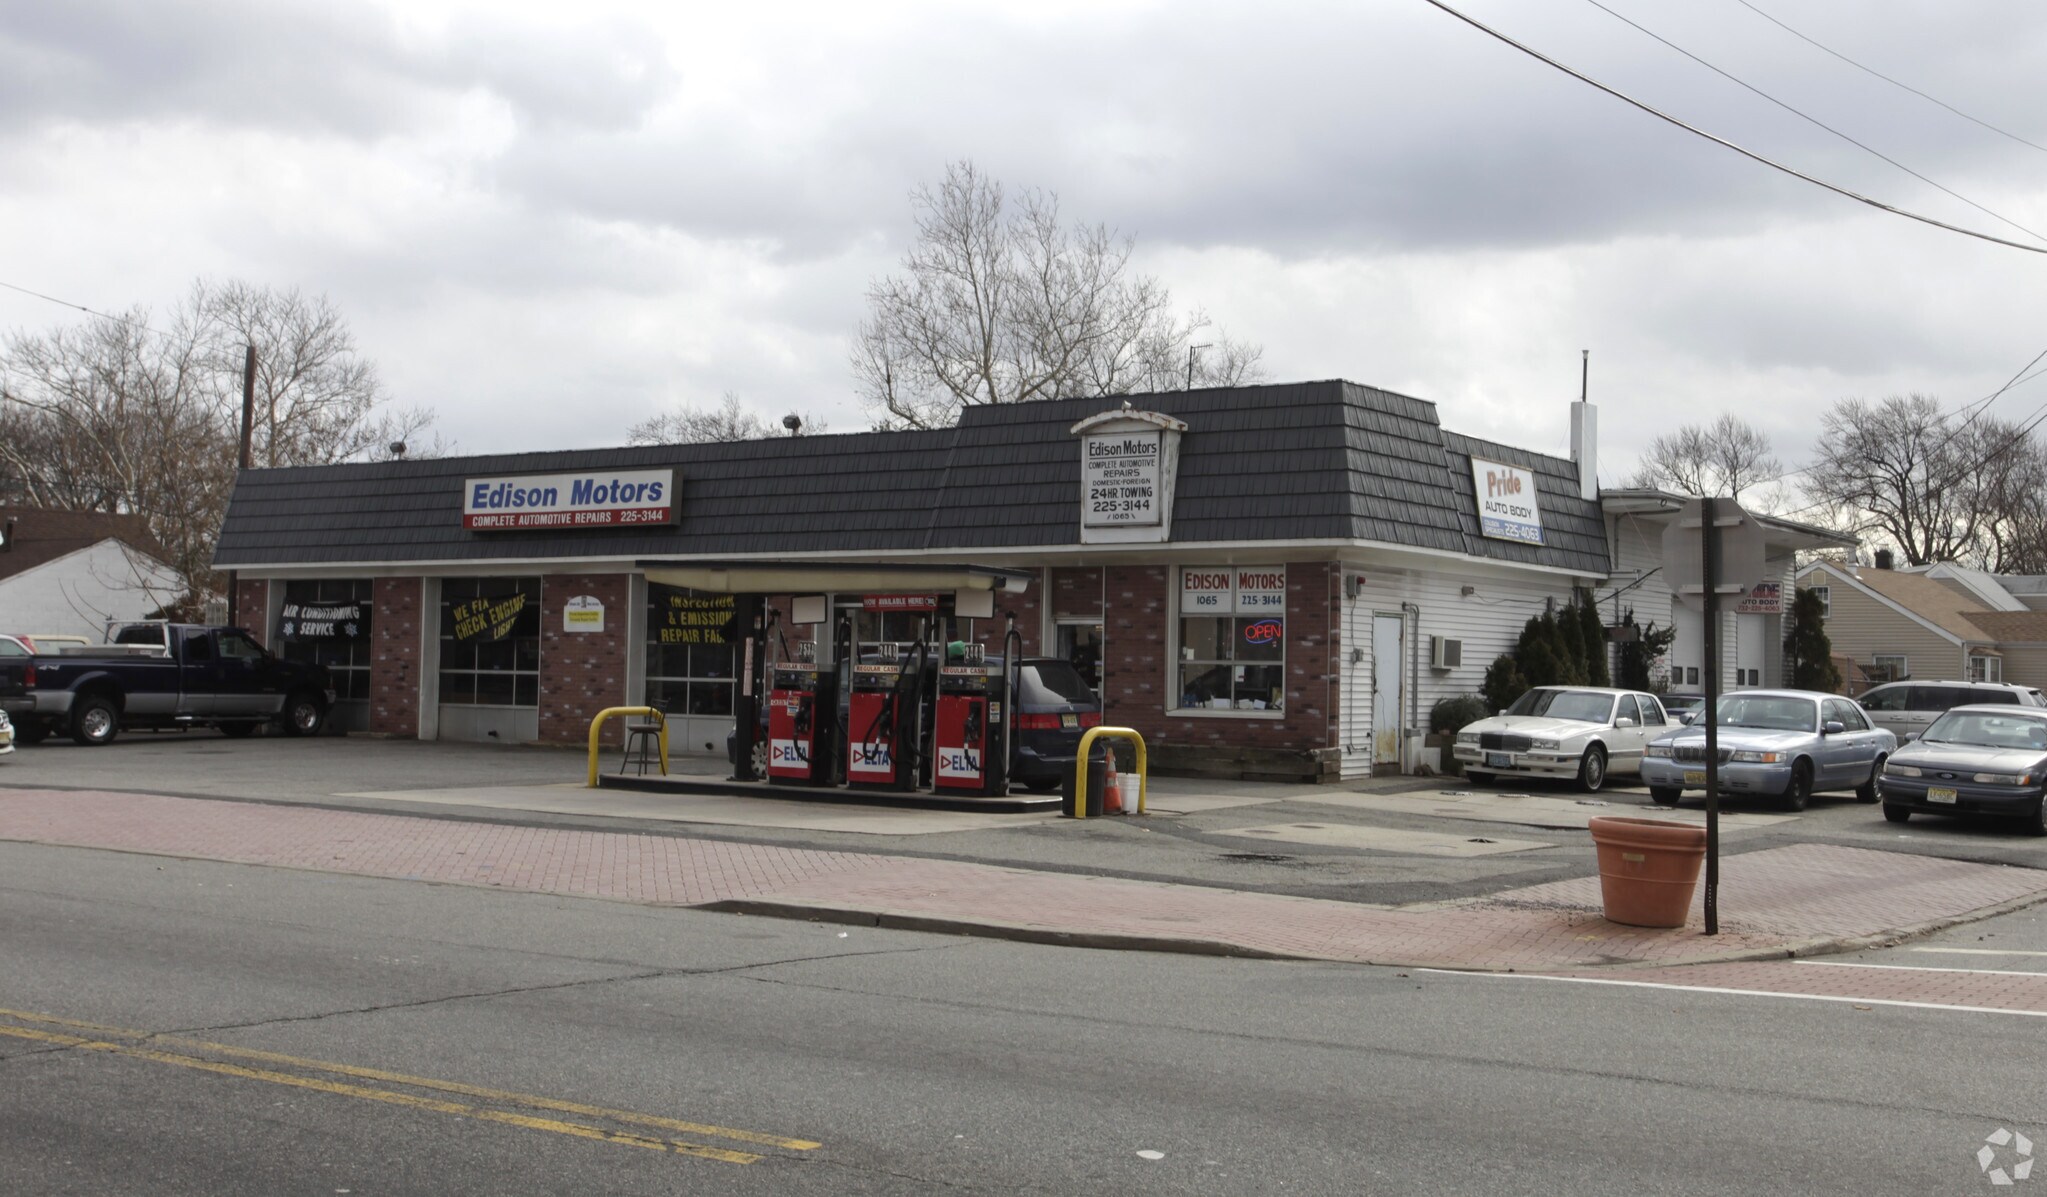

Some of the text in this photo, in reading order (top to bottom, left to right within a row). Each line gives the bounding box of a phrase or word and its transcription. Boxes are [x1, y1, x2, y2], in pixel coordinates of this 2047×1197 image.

[1089, 440, 1157, 456] Edison Motors
[1088, 458, 1155, 470] COMPLETE AUTOMOTIVE
[1103, 469, 1140, 478] REPAIRS
[1487, 469, 1521, 497] Pride
[472, 479, 663, 509] Edison Motors
[1120, 486, 1153, 498] TOWING
[1093, 500, 1150, 512] 225-3144
[1486, 501, 1531, 519] AUTO BODY
[472, 510, 663, 527] COMPLETE AUTOMOTIVE REPAIRS 225-3144
[1505, 522, 1539, 541] 225-4063
[1185, 572, 1284, 590] EDISON MOTORS
[1197, 595, 1217, 605] 1065
[282, 604, 360, 620] AIR CONDITIONING
[453, 598, 489, 621] WE FIX
[455, 593, 525, 640] CHECK ENGINE
[668, 611, 676, 625] &
[300, 622, 335, 636] SERVICE
[493, 616, 517, 640] LIGHT
[661, 628, 700, 642] REPAIR
[1244, 624, 1282, 639] OPEN
